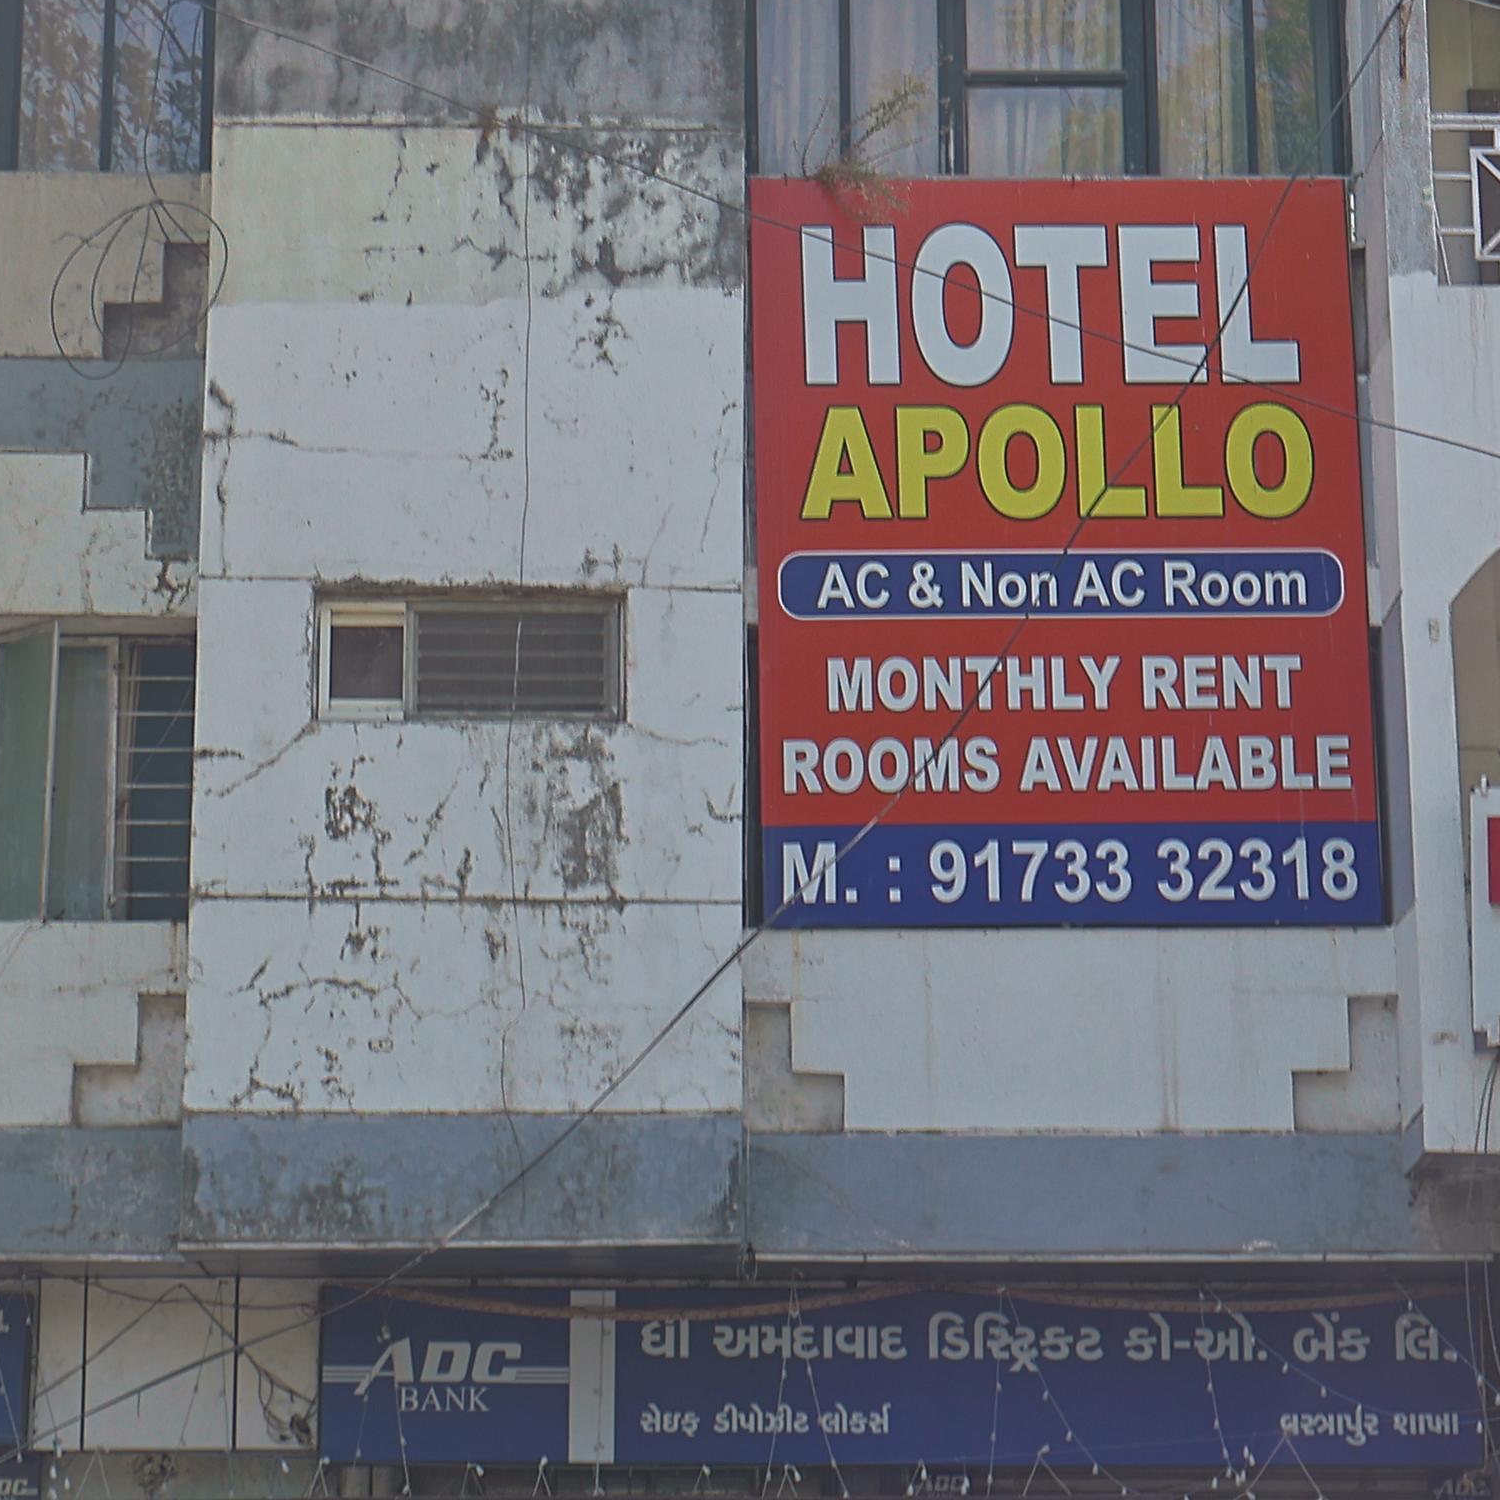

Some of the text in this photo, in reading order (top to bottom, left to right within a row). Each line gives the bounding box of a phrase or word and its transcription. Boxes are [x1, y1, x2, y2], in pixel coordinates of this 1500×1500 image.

[800, 222, 1301, 387] HOTEL
[800, 402, 1315, 520] APOLLO
[817, 560, 1308, 610] AC & Non AC Room
[825, 654, 1302, 712] MONTHLY RENT
[781, 735, 1353, 795] ROOMS AVAILABLE
[928, 839, 1133, 903] 91733
[1156, 838, 1360, 902] 32318
[713, 1325, 907, 1360] અમદાવાદ
[1293, 1312, 1370, 1362] બેંક
[354, 1337, 522, 1396] ADC
[399, 1387, 490, 1412] BANK
[1393, 1412, 1460, 1436] શાખા
